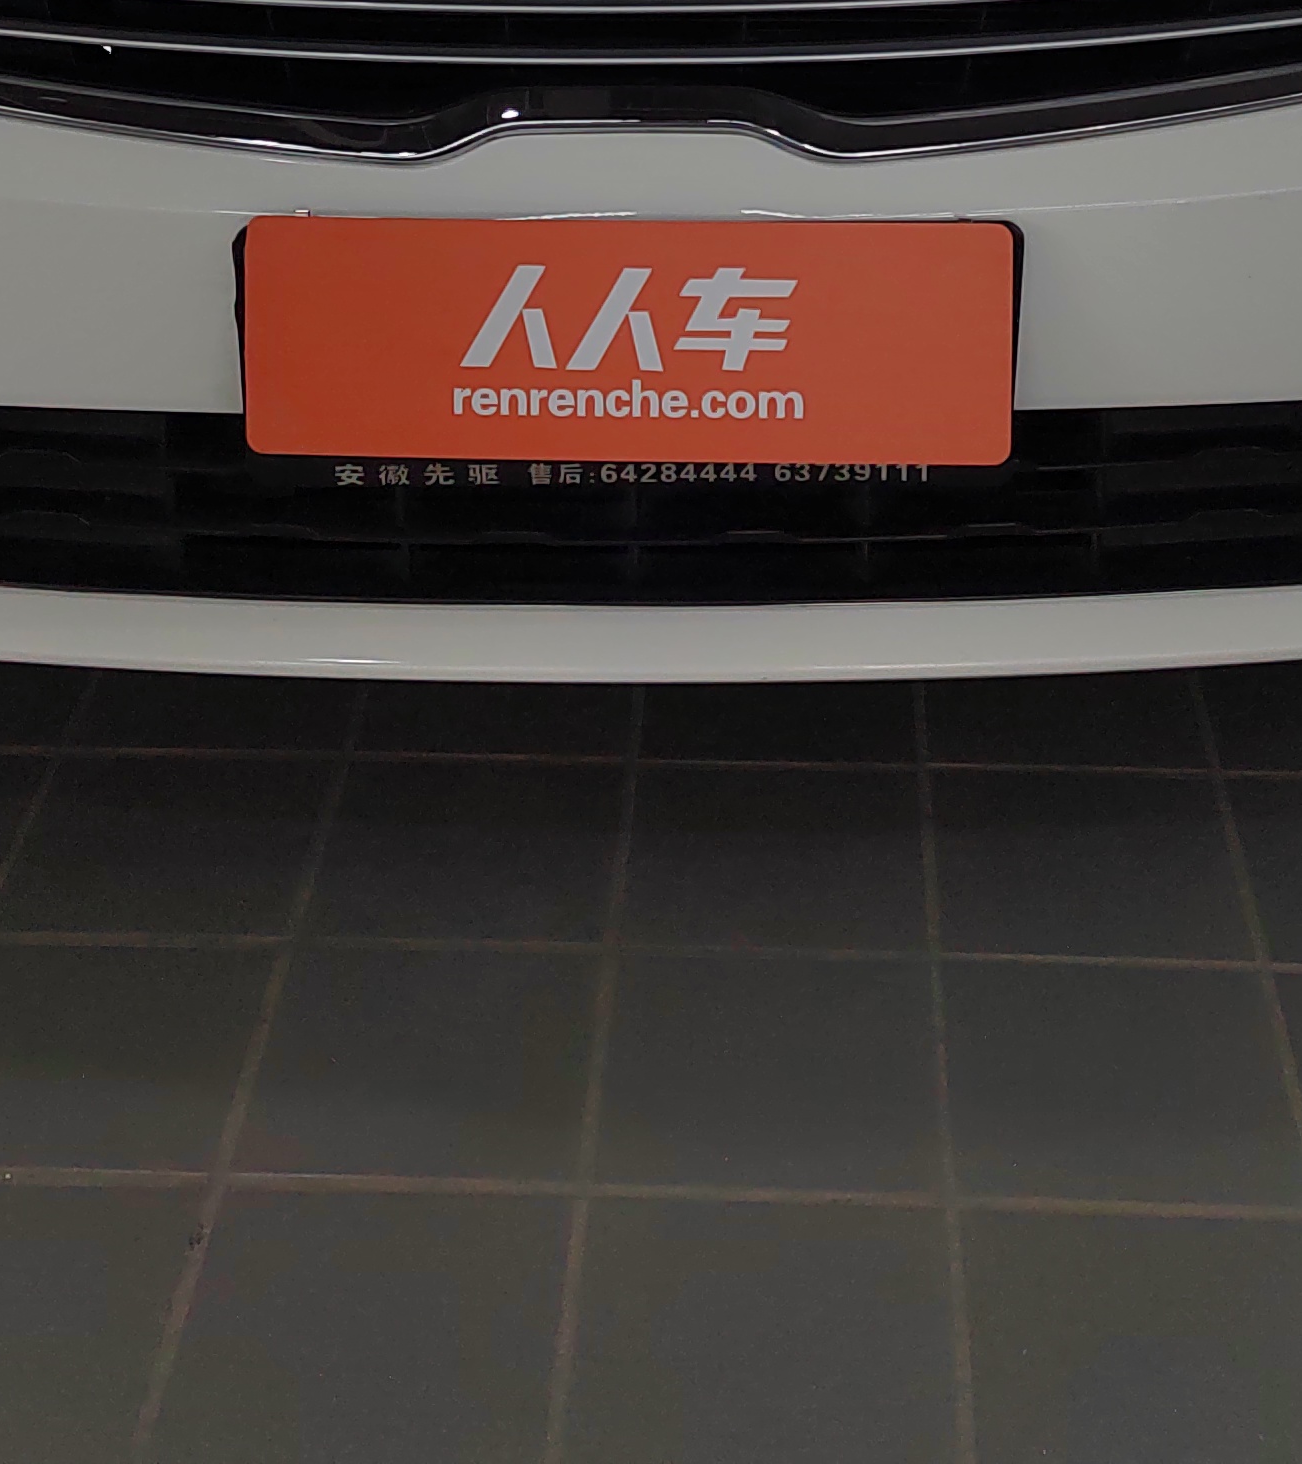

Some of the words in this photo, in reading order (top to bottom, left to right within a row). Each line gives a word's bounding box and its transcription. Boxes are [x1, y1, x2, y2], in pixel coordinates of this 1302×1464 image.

[460, 264, 799, 372] 人人车
[452, 381, 805, 420] renrenche.com
[335, 462, 501, 487] 安徽先驱
